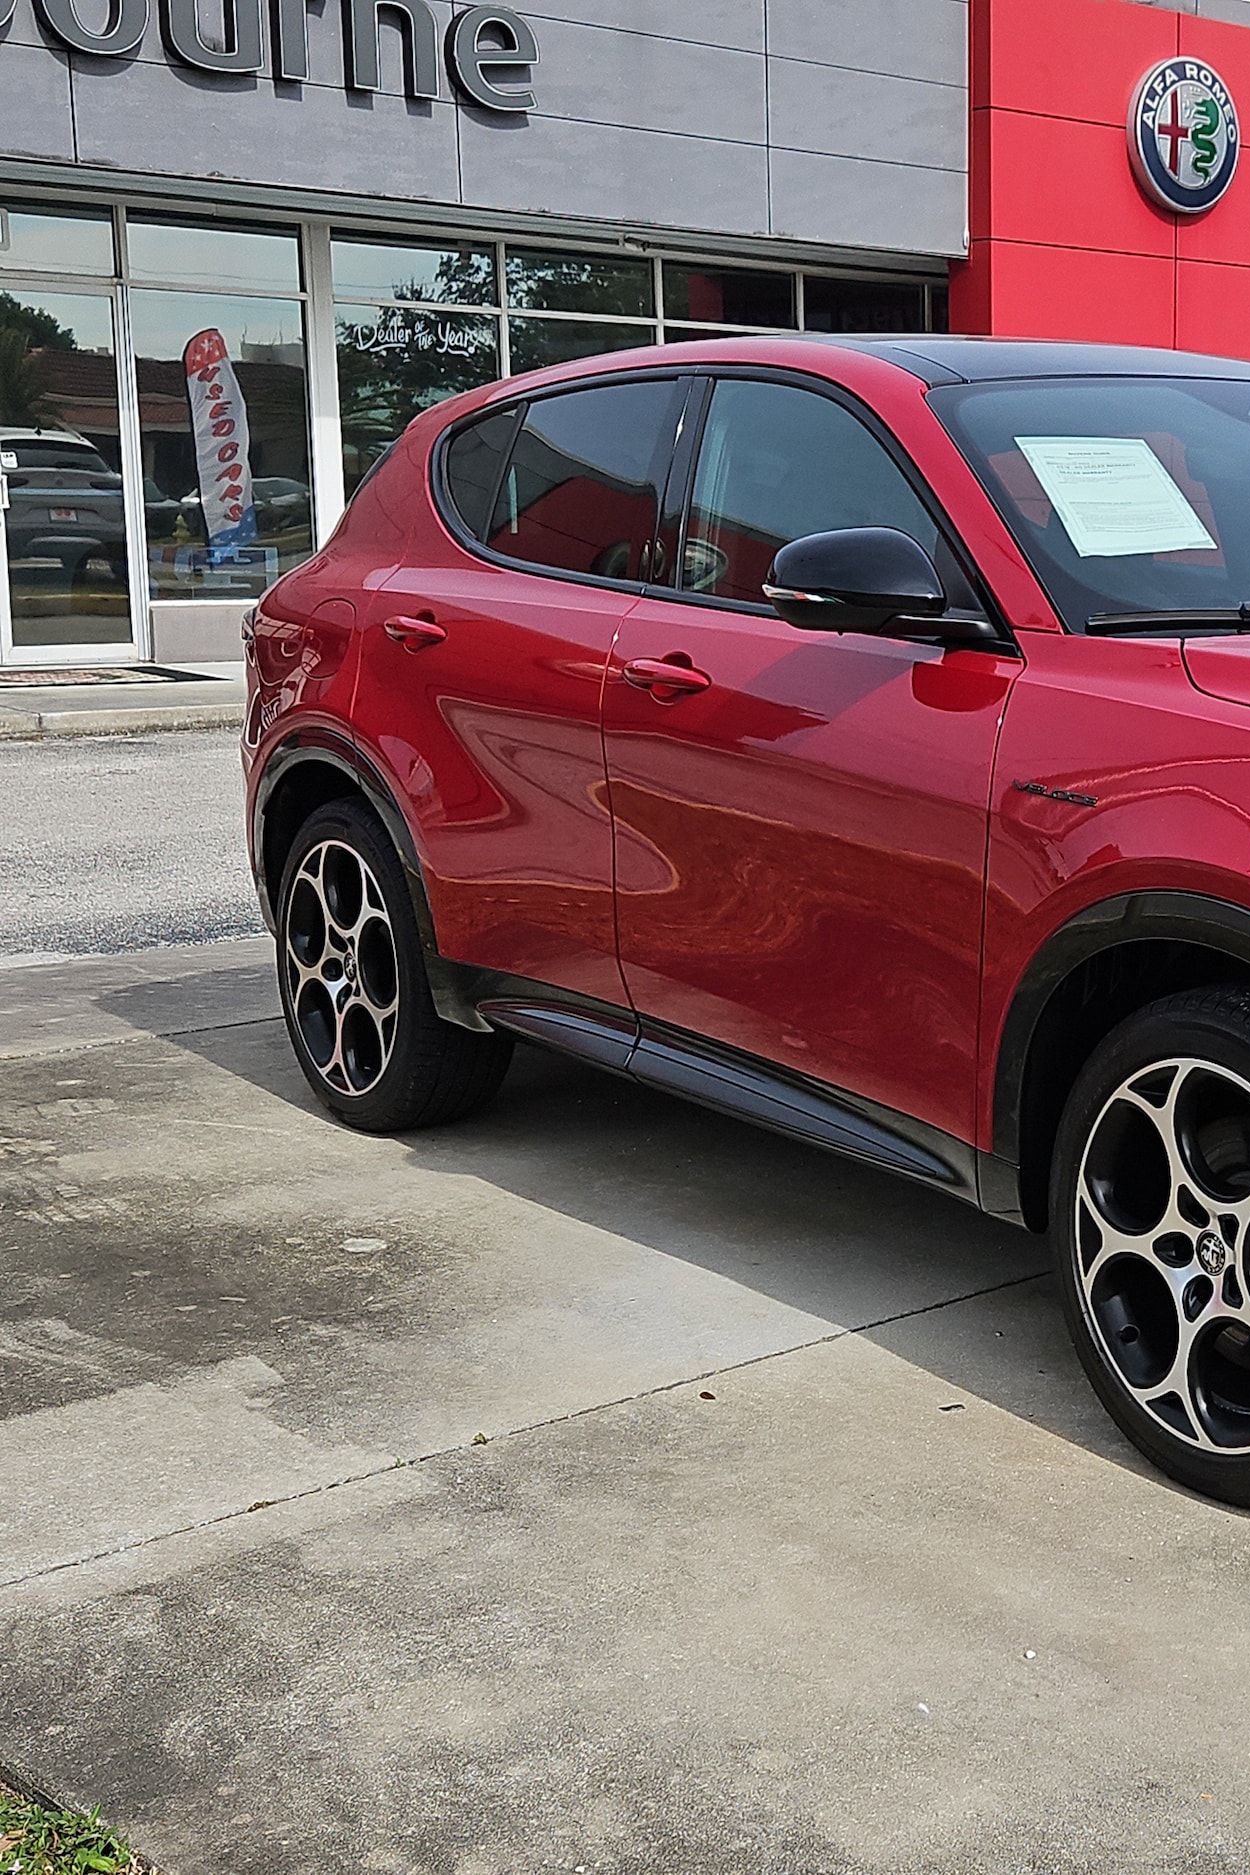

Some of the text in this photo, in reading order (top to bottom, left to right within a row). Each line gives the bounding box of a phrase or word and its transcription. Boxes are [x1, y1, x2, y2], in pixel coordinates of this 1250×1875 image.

[1142, 63, 1237, 144] ALFA ROMEO
[353, 317, 412, 350] Dealer
[414, 320, 425, 333] OF
[197, 366, 236, 438] USED
[1013, 779, 1098, 807] VELOCE
